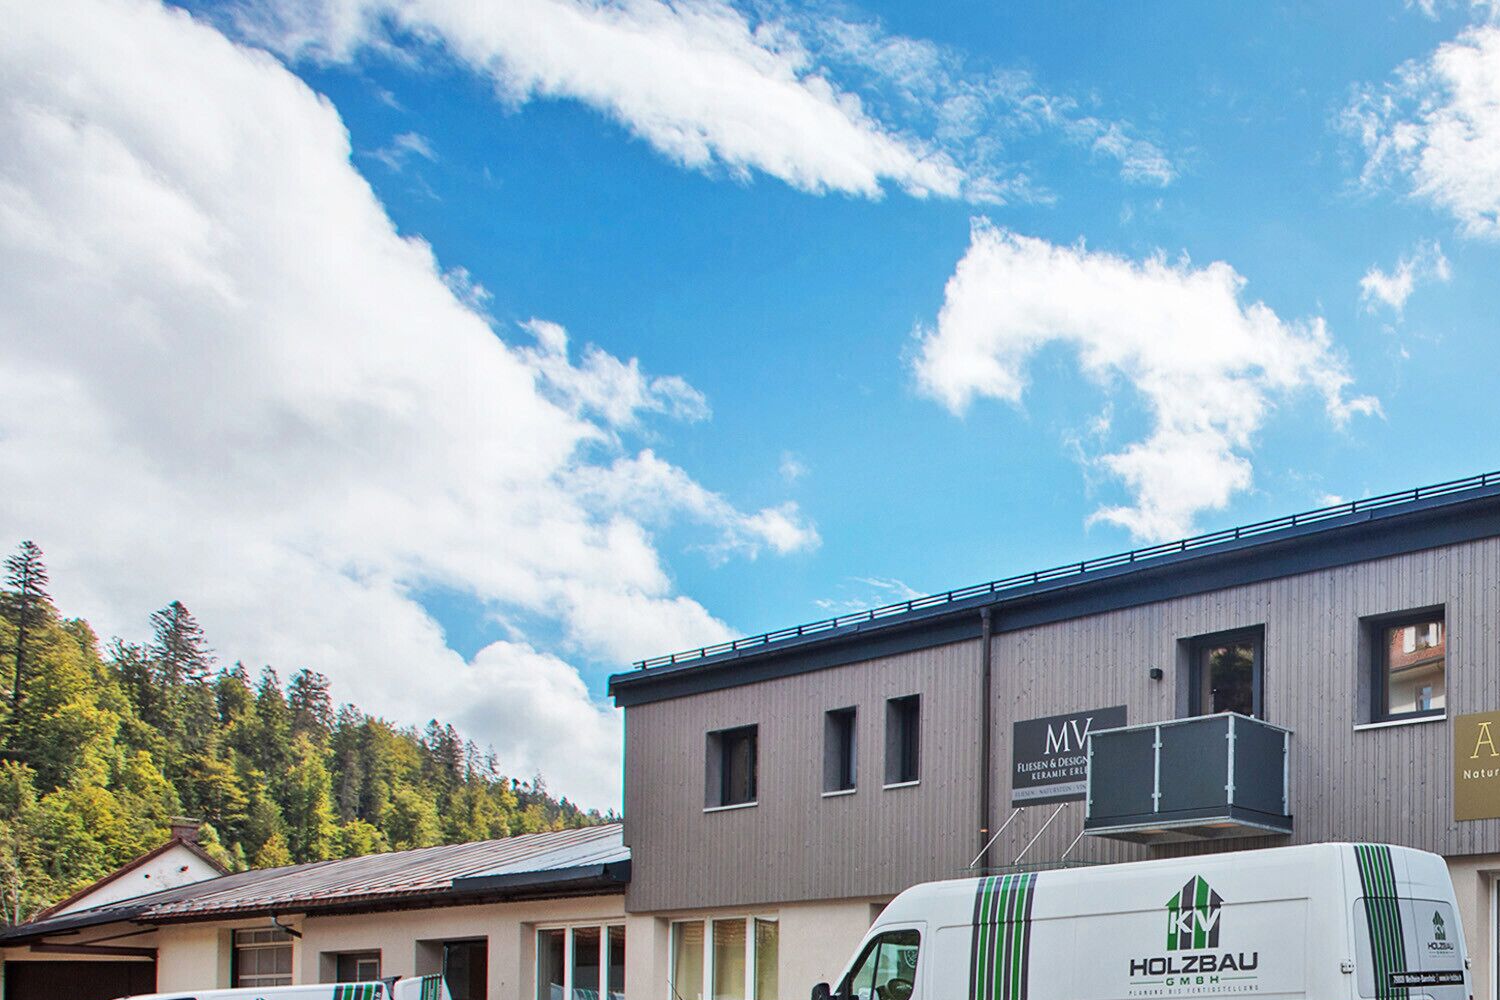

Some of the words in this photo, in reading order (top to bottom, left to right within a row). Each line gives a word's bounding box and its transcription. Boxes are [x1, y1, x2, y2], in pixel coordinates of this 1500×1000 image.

[1044, 717, 1093, 754] MV
[1017, 760, 1049, 773] FLIESEN
[1050, 758, 1057, 768] &
[1031, 769, 1067, 780] KERAMIK
[1169, 907, 1221, 935] KV
[1129, 951, 1258, 977] HOLZBAU
[1165, 975, 1219, 986] GMBH
